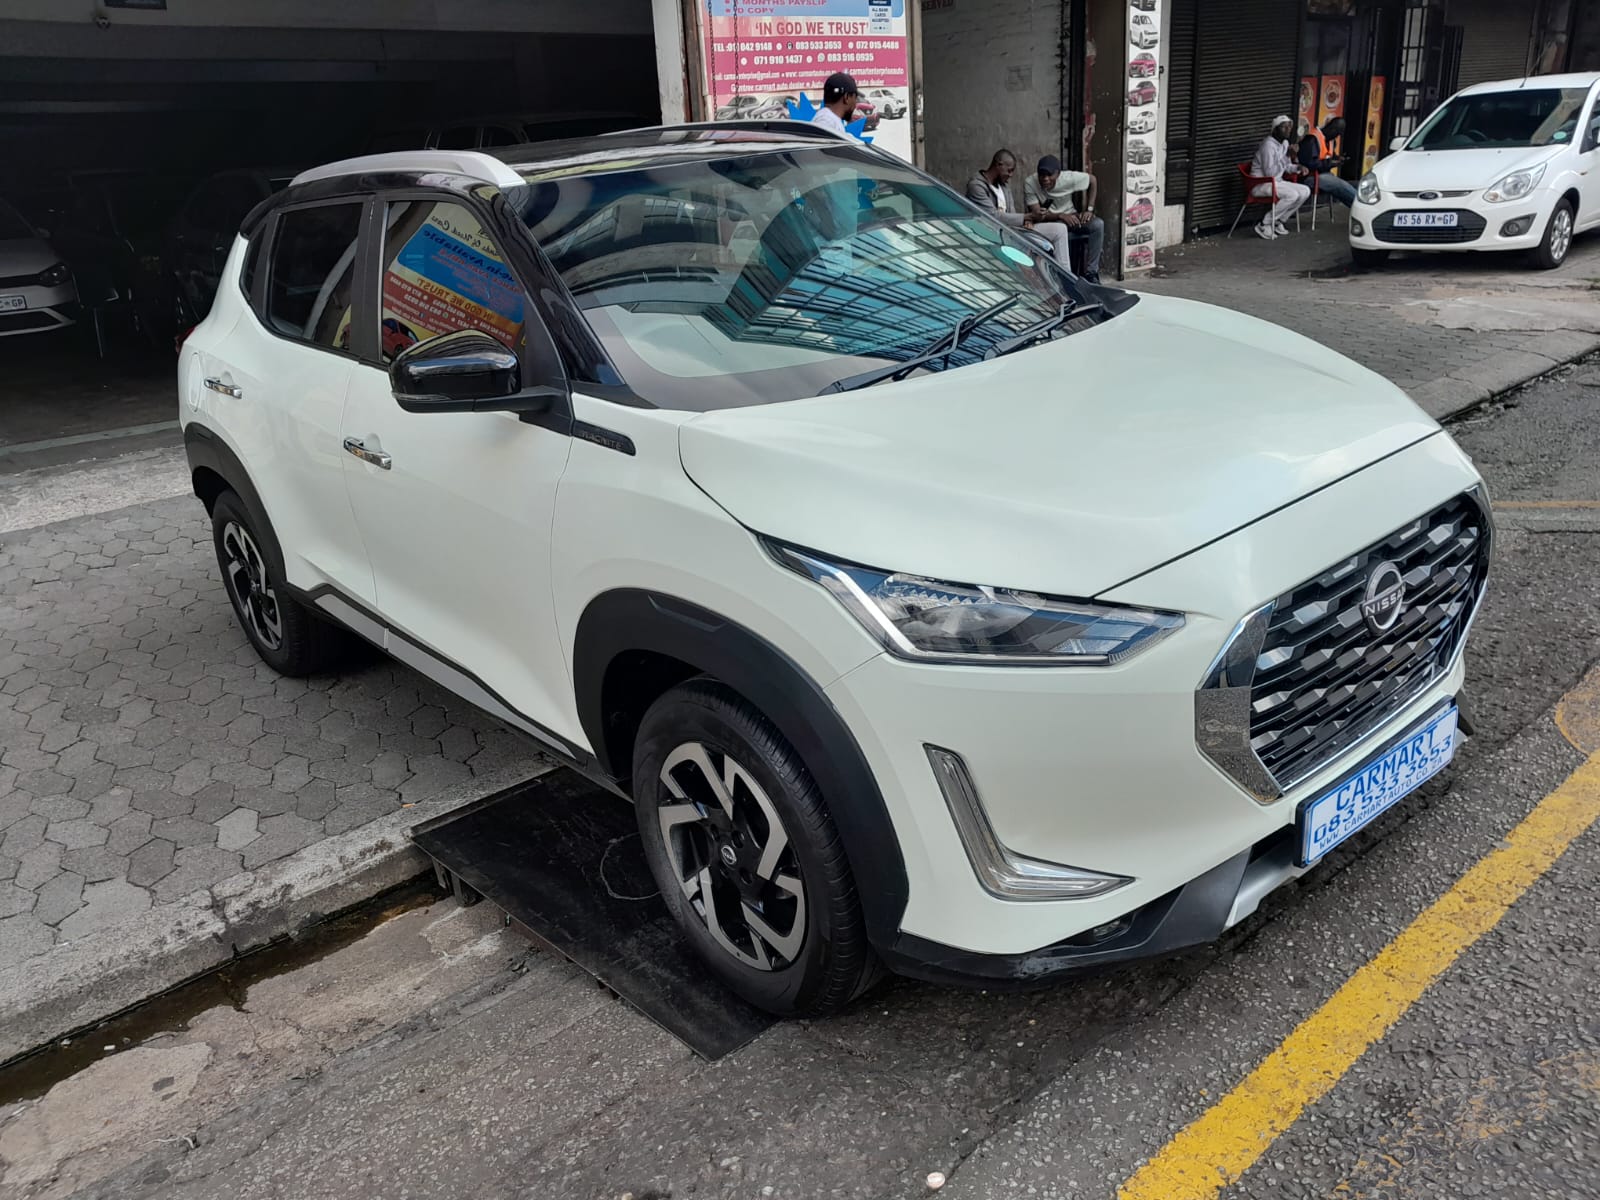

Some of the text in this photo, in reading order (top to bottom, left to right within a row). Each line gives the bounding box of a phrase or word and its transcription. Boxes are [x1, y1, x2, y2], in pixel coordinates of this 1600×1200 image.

[776, 22, 802, 34] GOD
[806, 22, 824, 34] WE
[754, 56, 768, 64] 071
[1397, 214, 1455, 225] MS 56 RX GP
[11, 298, 23, 307] GP
[1336, 724, 1438, 812] CARMART
[1314, 735, 1452, 844] 083 533 3653
